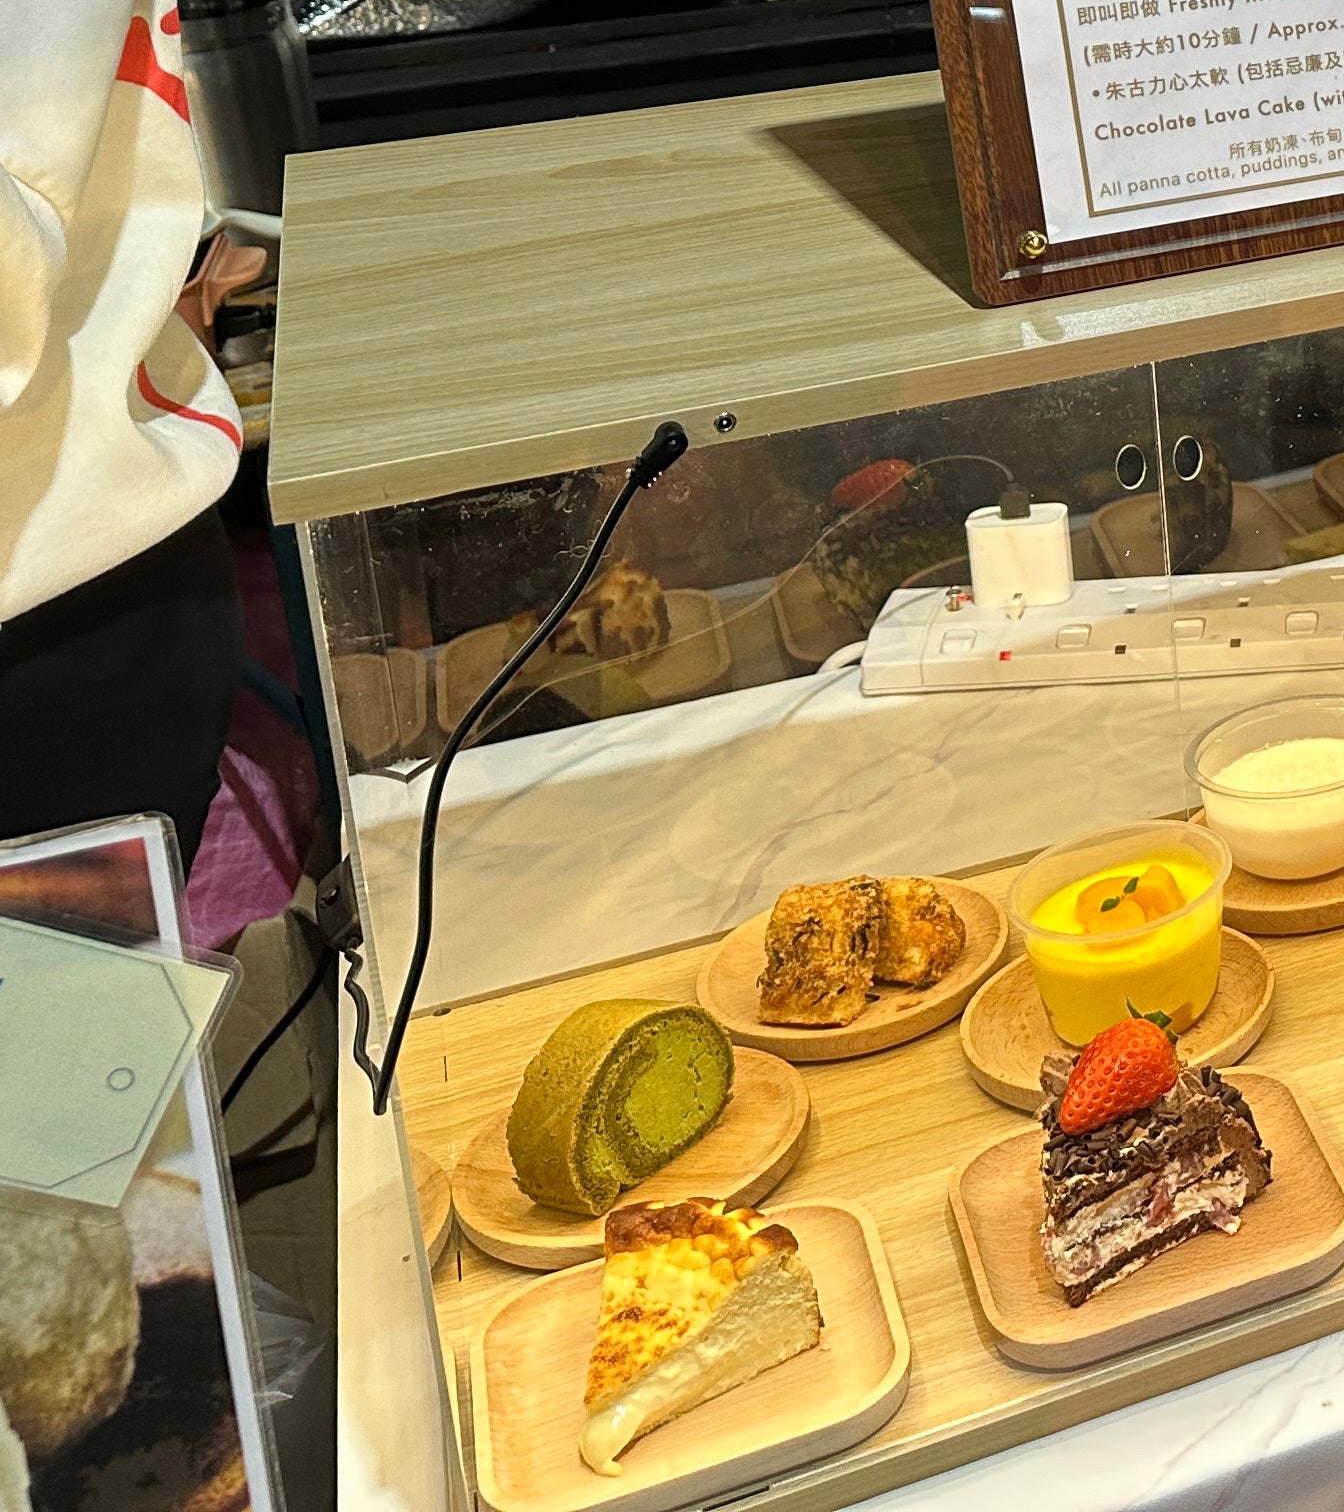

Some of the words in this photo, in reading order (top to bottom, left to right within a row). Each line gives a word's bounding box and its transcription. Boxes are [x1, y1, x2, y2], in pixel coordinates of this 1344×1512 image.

[1267, 18, 1344, 41] Approx.
[1105, 66, 1229, 100] 朱古力心太軟
[1094, 114, 1196, 141] Chocolate
[1204, 107, 1250, 125] Lava
[1257, 95, 1305, 116] Cake
[1100, 180, 1122, 198] All
[1127, 174, 1181, 196] panna
[1186, 166, 1235, 184] cotta,
[1240, 152, 1322, 178] puddings,
